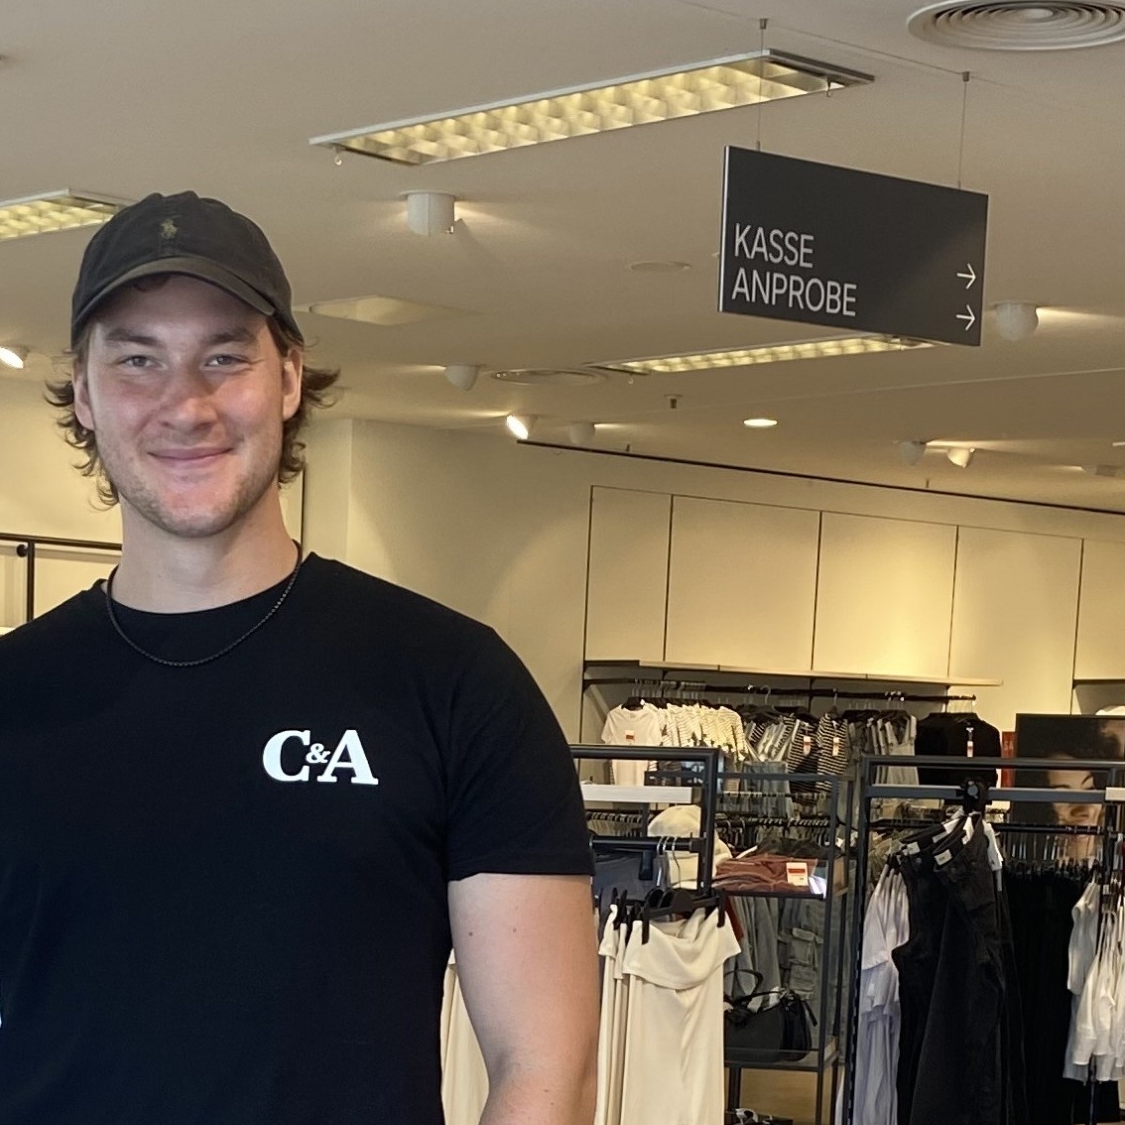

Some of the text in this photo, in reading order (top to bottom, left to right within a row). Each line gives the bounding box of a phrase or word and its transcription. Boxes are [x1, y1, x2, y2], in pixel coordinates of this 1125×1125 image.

[734, 223, 814, 268] KASSE
[731, 267, 857, 317] ANPROBE
[262, 729, 379, 785] C&A
